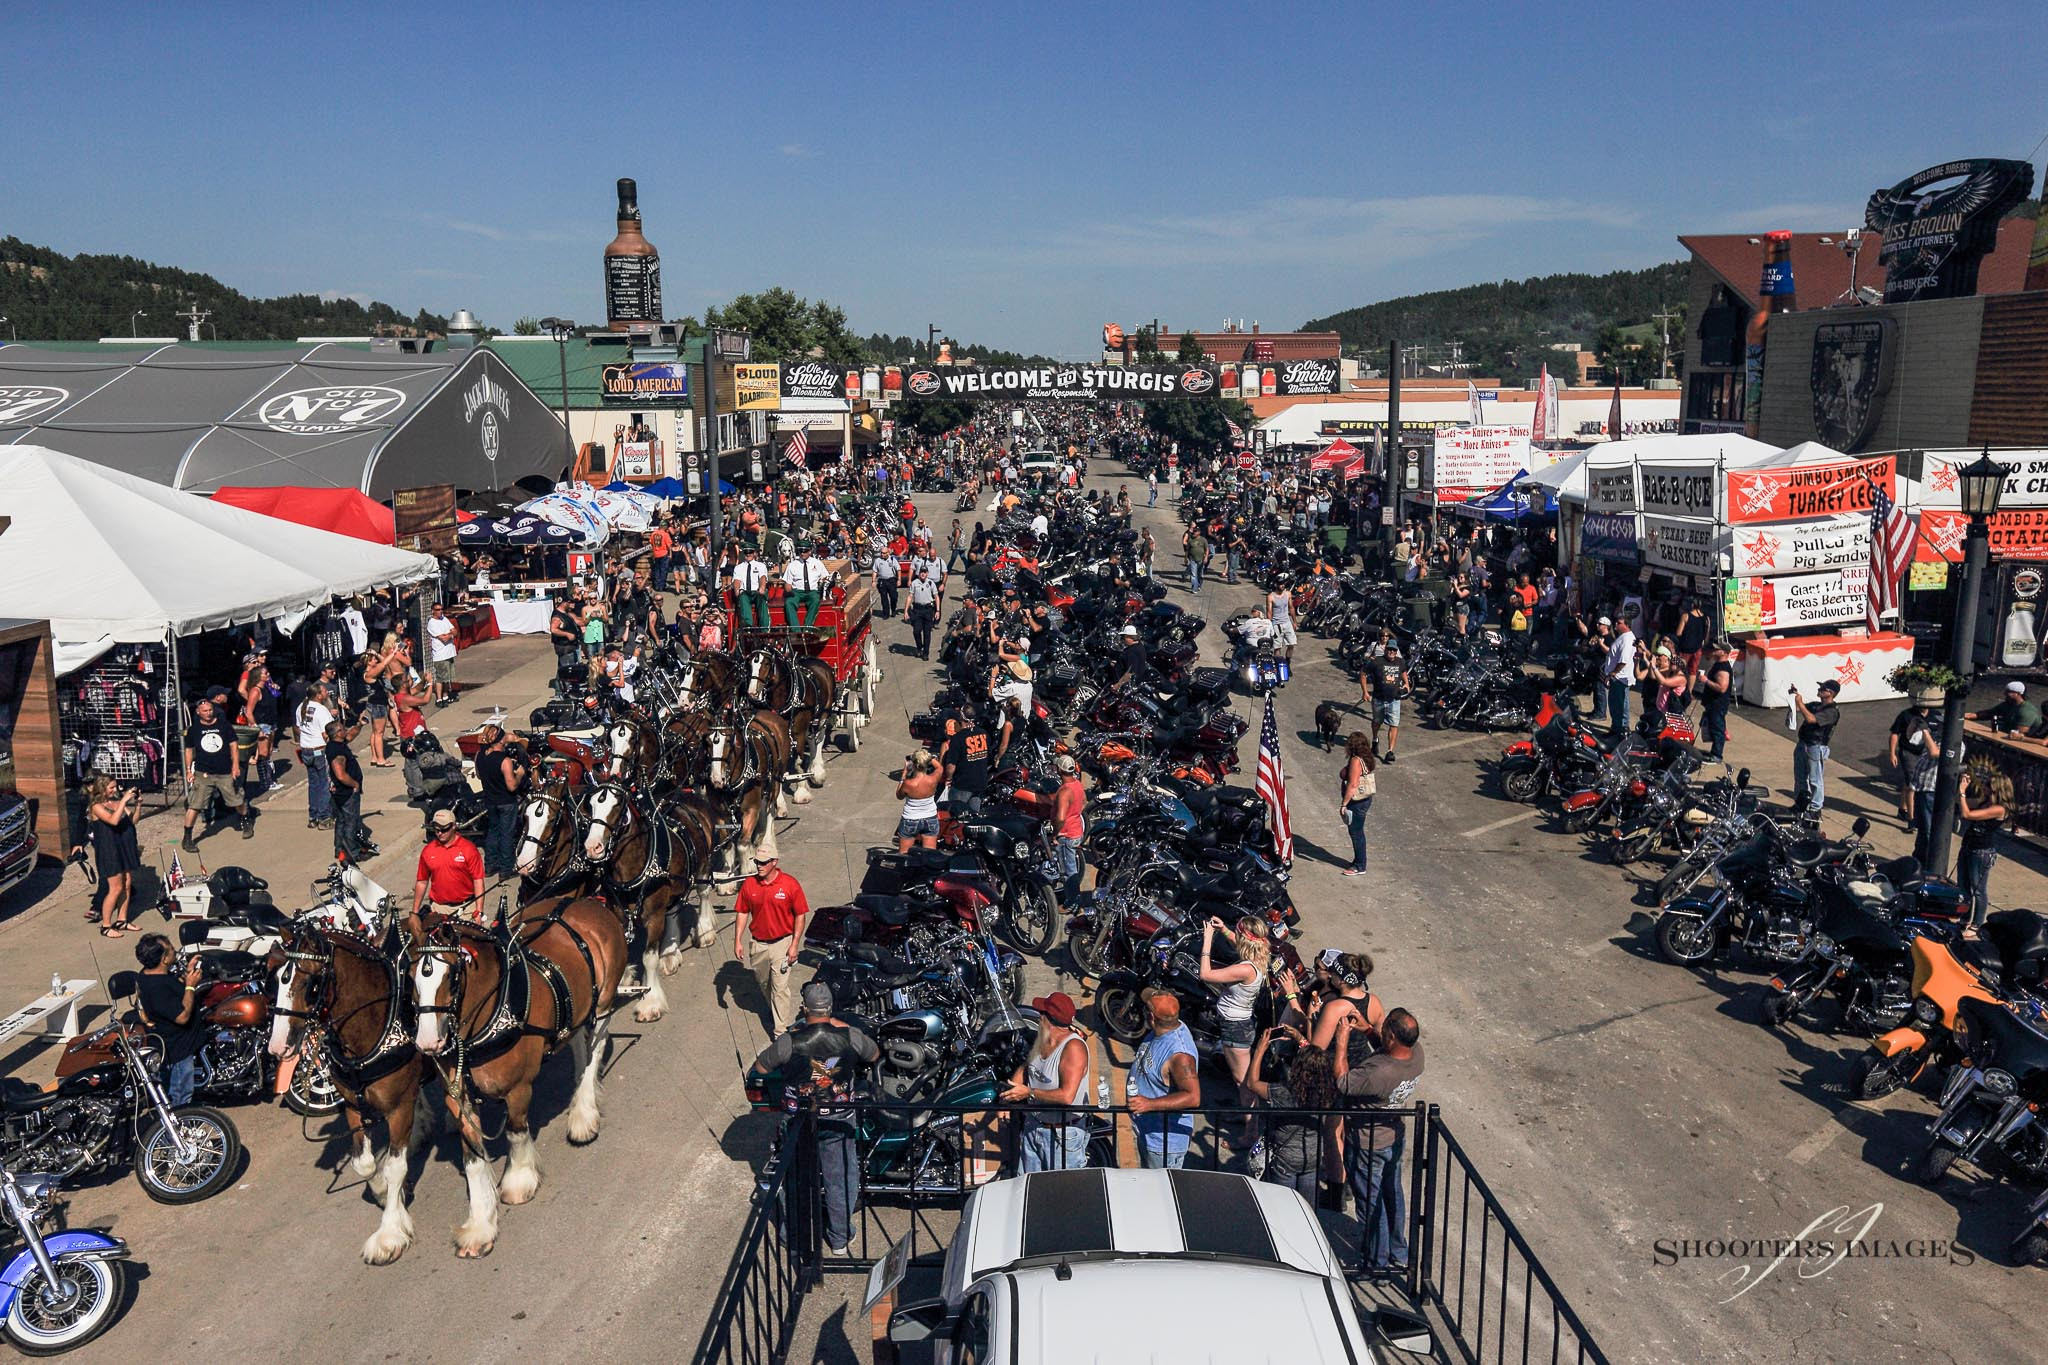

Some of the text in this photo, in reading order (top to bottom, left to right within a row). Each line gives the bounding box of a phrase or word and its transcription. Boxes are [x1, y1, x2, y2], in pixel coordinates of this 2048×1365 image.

[1909, 213, 1962, 238] BROWN
[1913, 233, 1954, 249] ATTORNEYS
[806, 362, 823, 374] Ole
[1303, 360, 1320, 371] Ole
[749, 369, 777, 379] LOUD
[785, 365, 840, 389] Smoky
[1282, 362, 1336, 386] Smoky
[608, 377, 683, 392] LOUD AMERICAN
[945, 370, 1053, 394] WELCOME
[1082, 370, 1175, 392] STURGIS
[326, 389, 377, 398] OLD
[791, 386, 834, 398] Moonshine
[1026, 388, 1098, 399] Shine Responsibly
[464, 382, 484, 423] JACK
[1436, 428, 1456, 439] Knives
[1472, 427, 1493, 437] Knives
[1509, 426, 1530, 437] Knives
[1463, 440, 1502, 450] More Knives
[1789, 462, 1888, 487] JUMBO SMOKED
[1788, 489, 1845, 515] TURKEY
[1988, 513, 2031, 526] UMBO
[1611, 519, 1634, 539] FOOD
[1661, 526, 1711, 546] TEXAS BEEF
[1795, 526, 1809, 534] Try
[1811, 525, 1825, 533] Our
[1793, 535, 1844, 552] Pulled
[1660, 544, 1710, 568] BRISKET
[1793, 550, 1870, 569] Pig Sandw
[1842, 568, 1870, 579] GREE
[1847, 583, 1868, 594] FOO
[1786, 598, 1818, 610] Texas
[1799, 603, 1864, 621] Sandwich $
